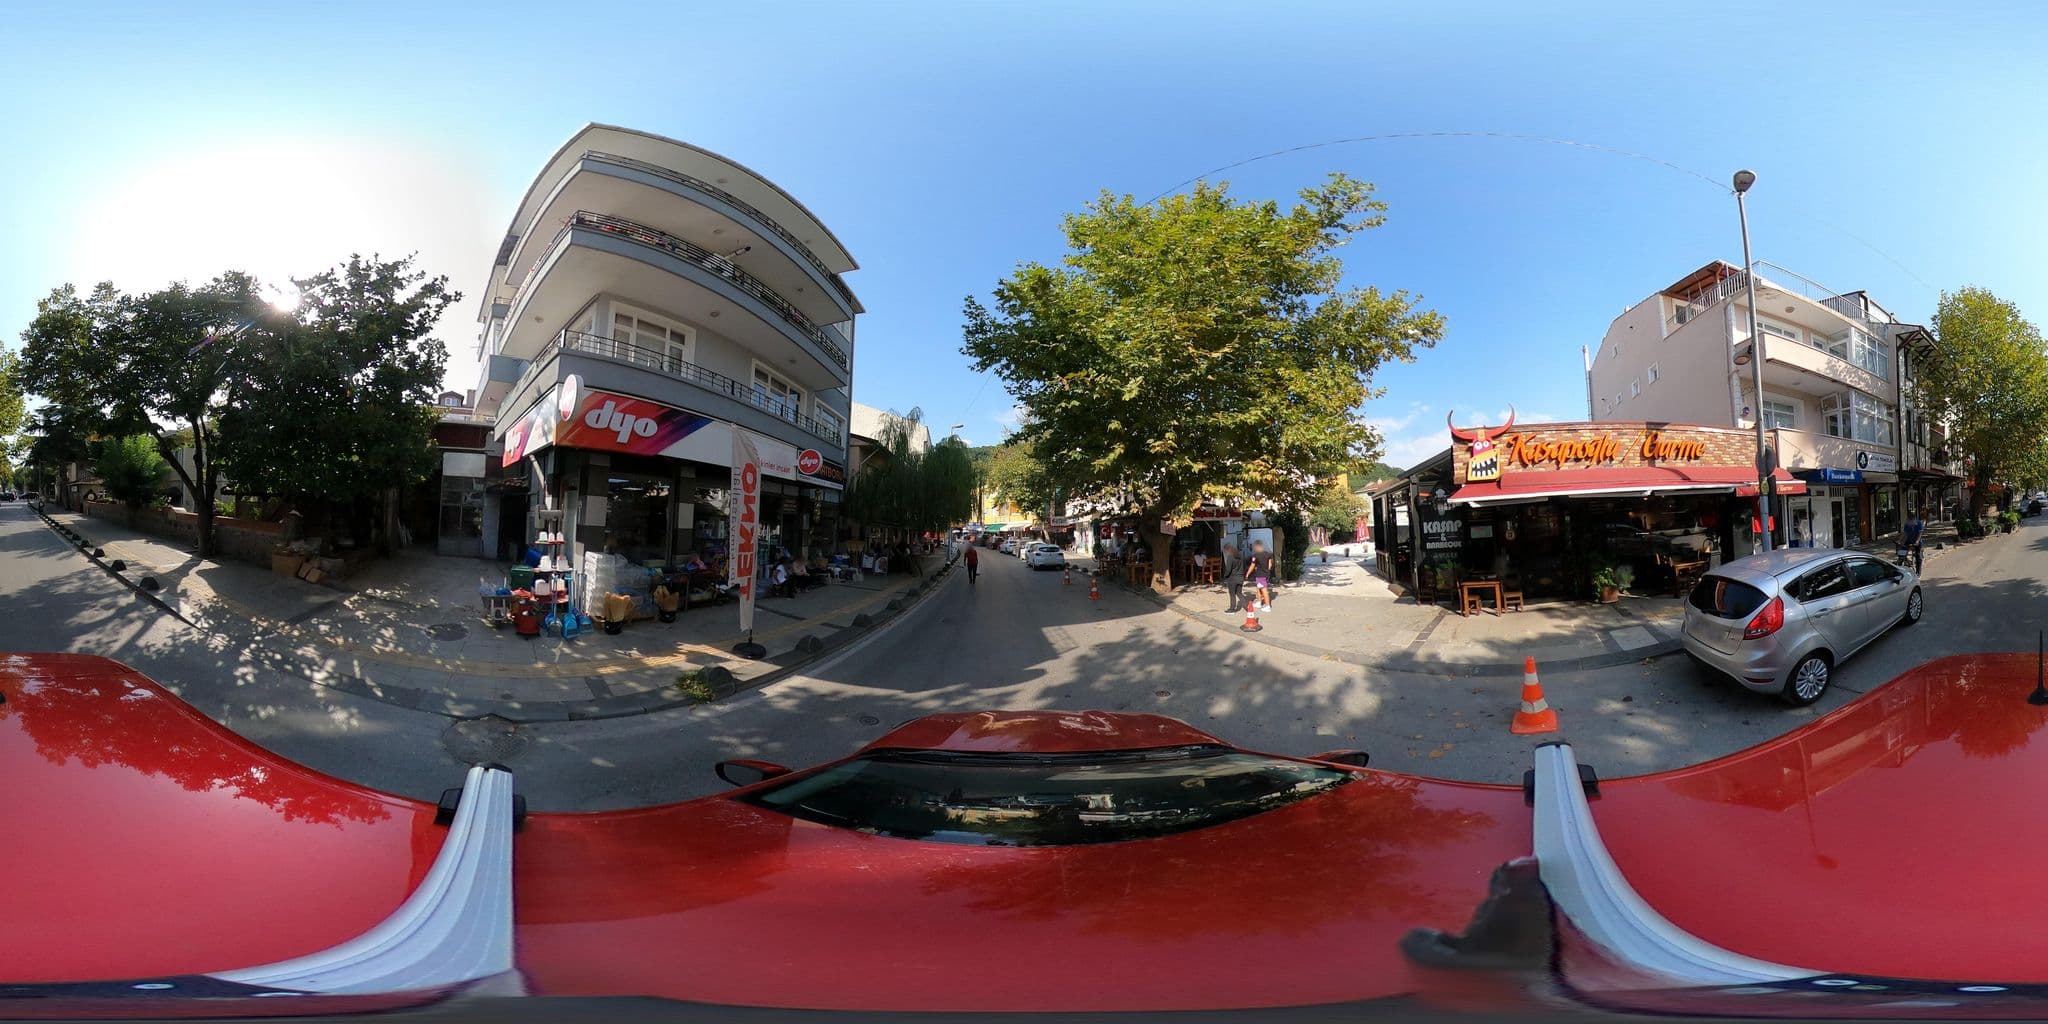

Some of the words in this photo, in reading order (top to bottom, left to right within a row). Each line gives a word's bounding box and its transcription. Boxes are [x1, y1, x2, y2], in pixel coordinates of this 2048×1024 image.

[585, 401, 658, 443] dyo
[800, 457, 818, 467] dyo
[1423, 519, 1463, 534] KASAP
